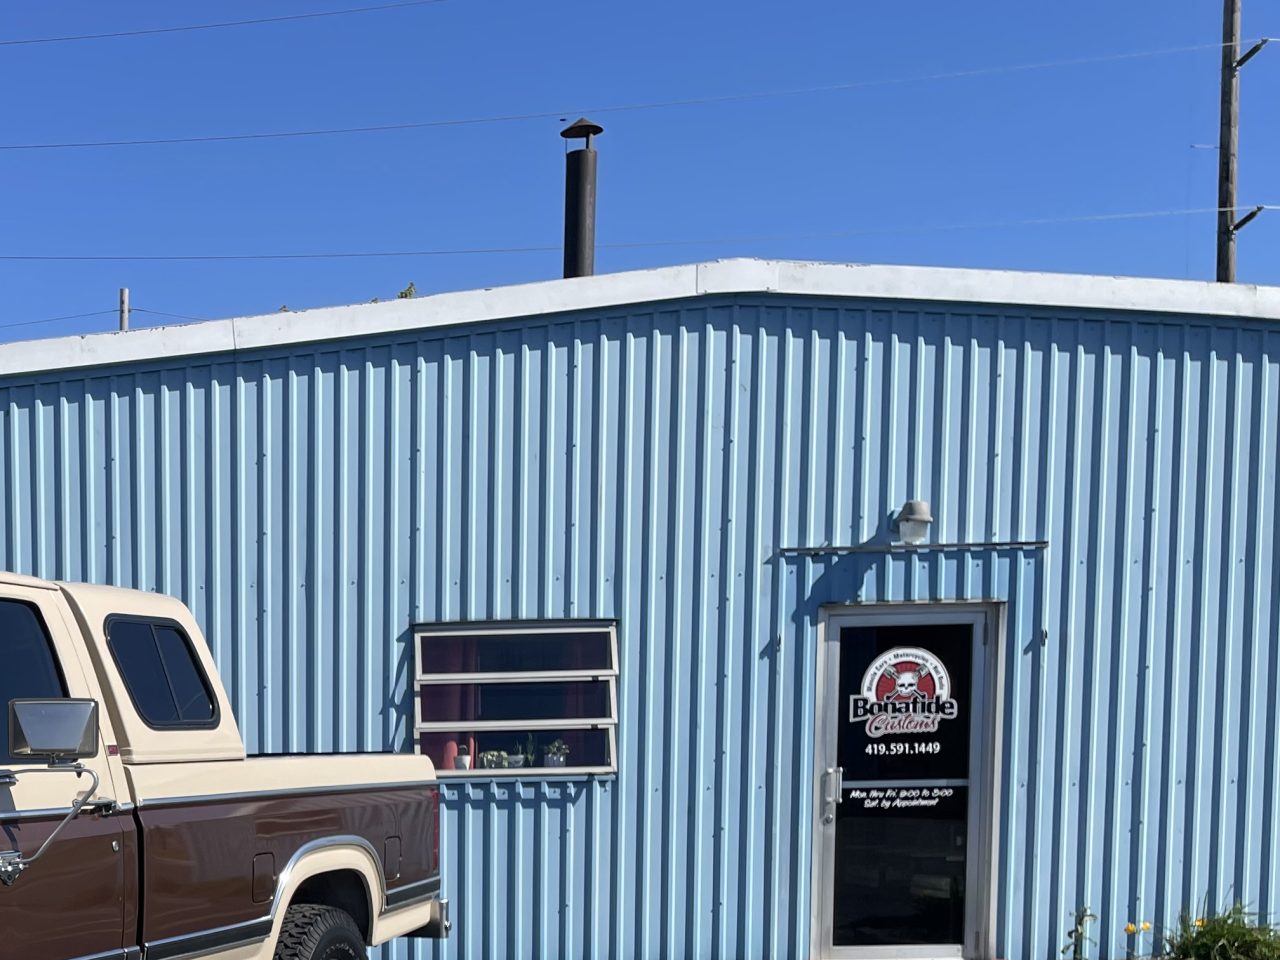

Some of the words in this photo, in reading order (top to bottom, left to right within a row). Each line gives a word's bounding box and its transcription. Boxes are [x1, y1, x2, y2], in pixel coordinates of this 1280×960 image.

[852, 695, 955, 719] Bonafide
[867, 712, 938, 736] Customs
[864, 741, 941, 755] 419.591.1449
[880, 799, 891, 810] by
[891, 797, 939, 808] Appointment
